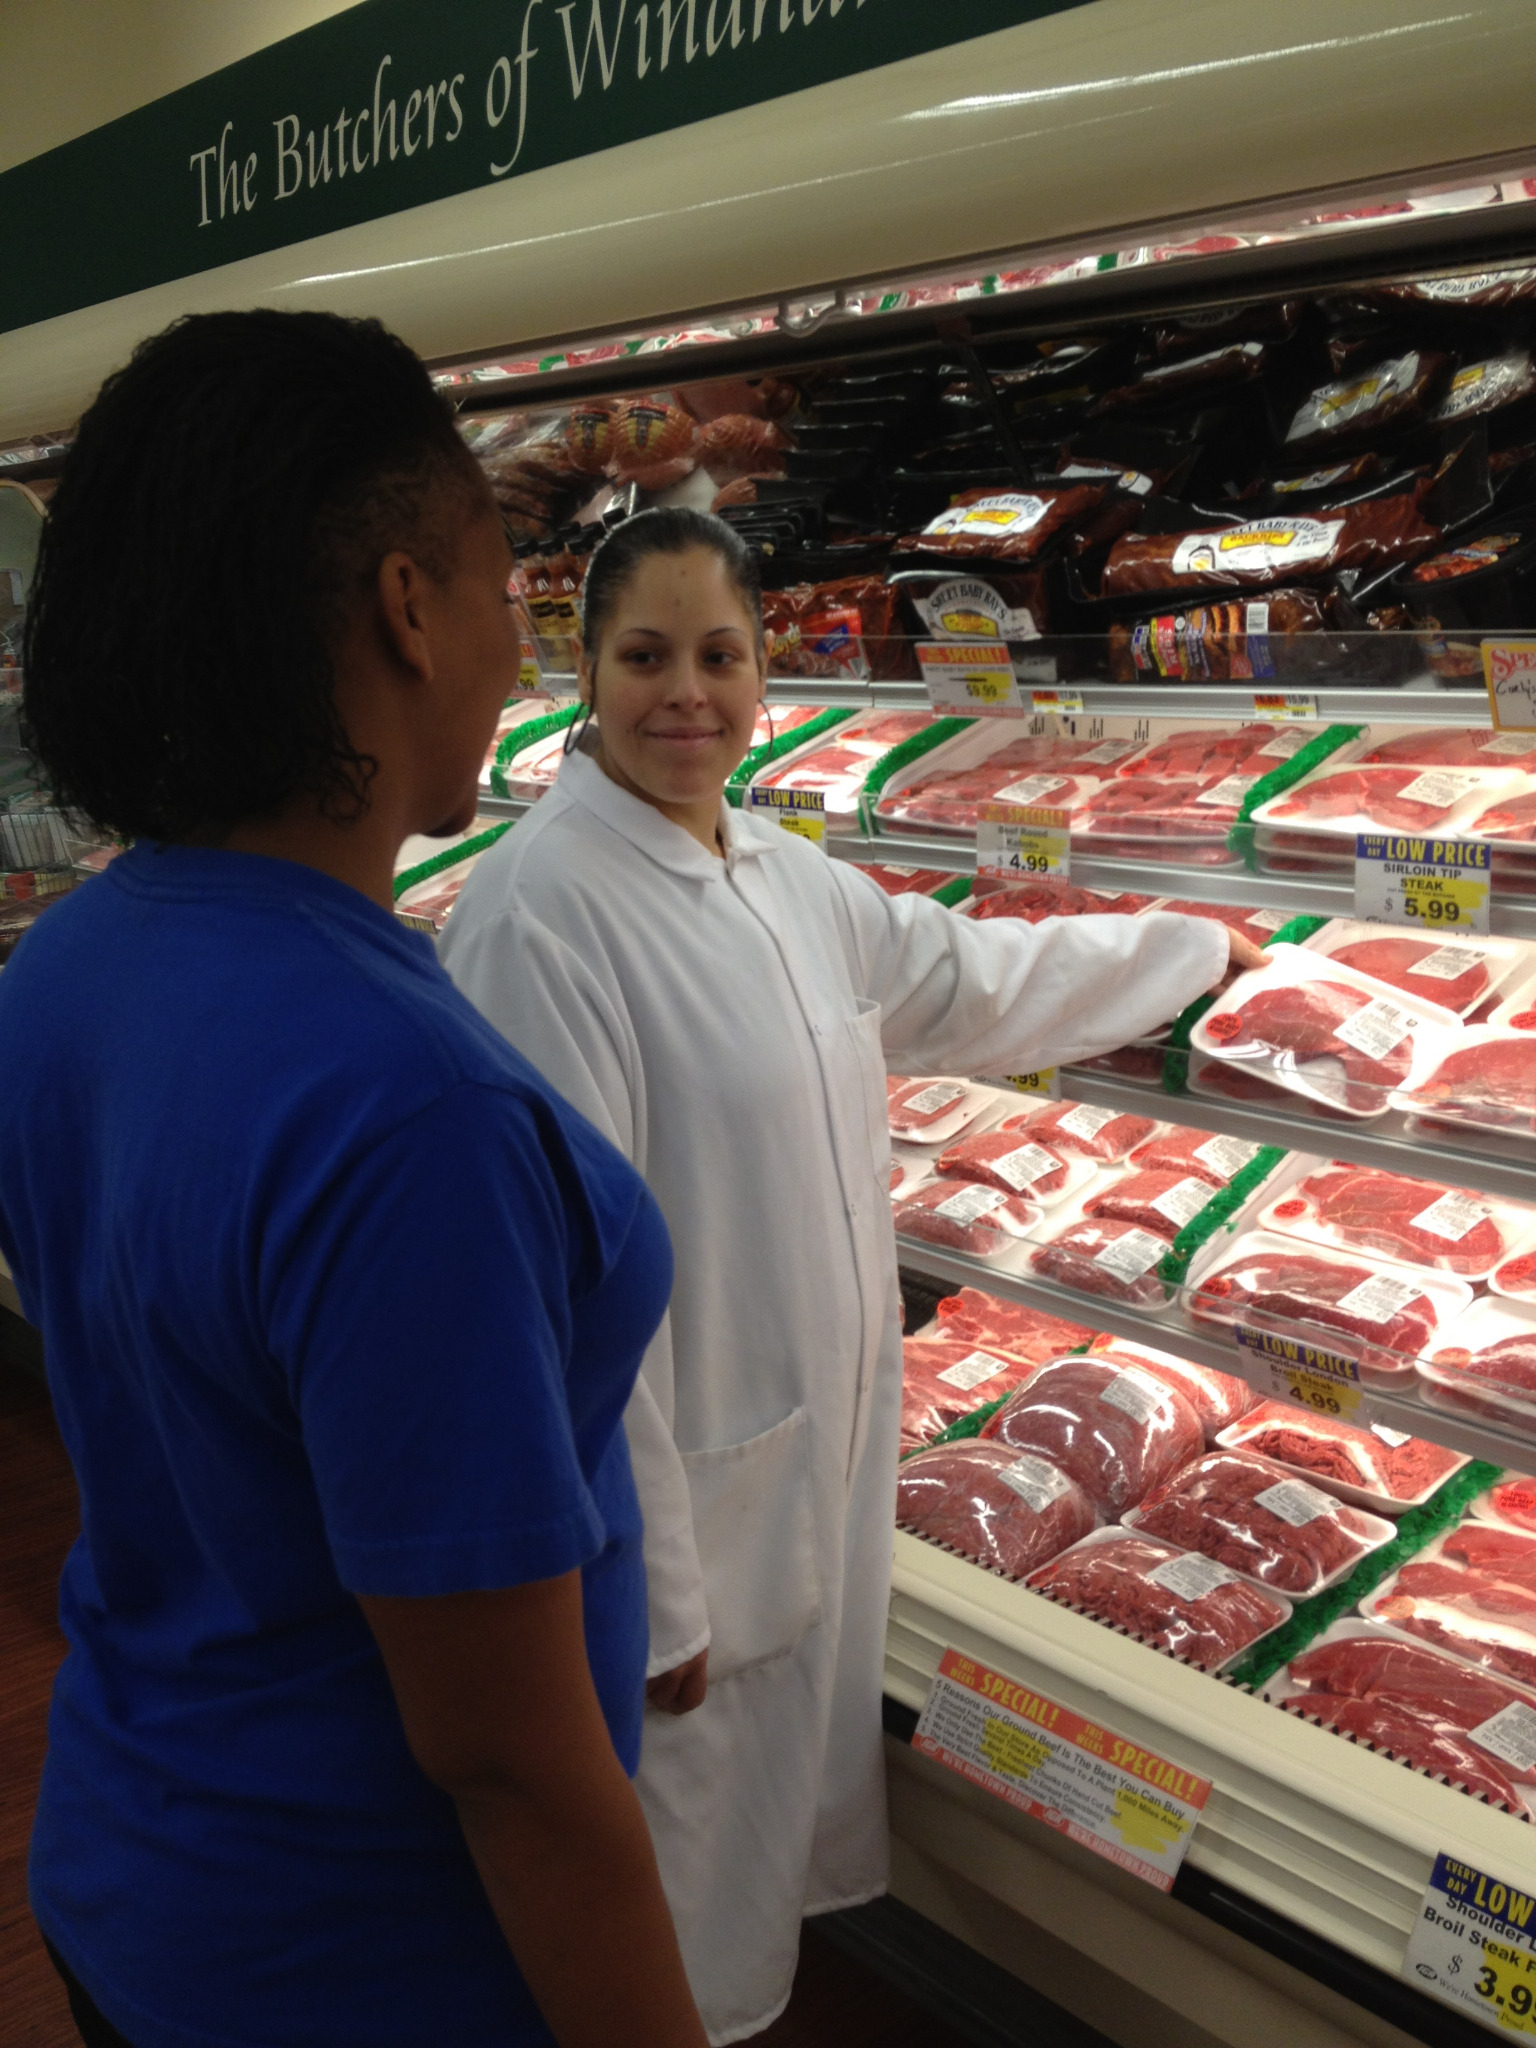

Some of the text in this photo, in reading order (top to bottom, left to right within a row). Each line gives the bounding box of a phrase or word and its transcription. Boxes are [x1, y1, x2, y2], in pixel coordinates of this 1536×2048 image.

[190, 121, 258, 228] The
[273, 55, 466, 202] Butchers
[486, 1, 543, 177] of
[768, 789, 823, 811] LOW PRICE
[1364, 834, 1386, 847] EVERY
[1386, 837, 1486, 868] LOW PRICE
[1009, 853, 1049, 873] 4.99
[1383, 863, 1462, 880] SIRLOIN TIP
[1400, 877, 1444, 892] STEAK
[1404, 897, 1460, 922] 5.99
[1262, 1335, 1355, 1380] LOW PRICE
[1270, 1363, 1297, 1380] Broil
[1299, 1372, 1335, 1392] Steak
[1304, 1366, 1350, 1388] London
[1289, 1385, 1341, 1415] 4.99
[978, 1671, 1060, 1729] SPECIAL!
[934, 1678, 1186, 1821] 5 Reasons Our Ground Beef Is The Best You Can Buy
[1108, 1738, 1199, 1802] SPECIAL!
[1445, 1859, 1477, 1883] EVERY
[1446, 1877, 1467, 1896] DAY
[1474, 1876, 1535, 1929] LOW
[1446, 1896, 1525, 1944] Shoulder
[1424, 1906, 1465, 1937] Broil
[1469, 1930, 1521, 1968] Steak
[1448, 1954, 1464, 1975] $
